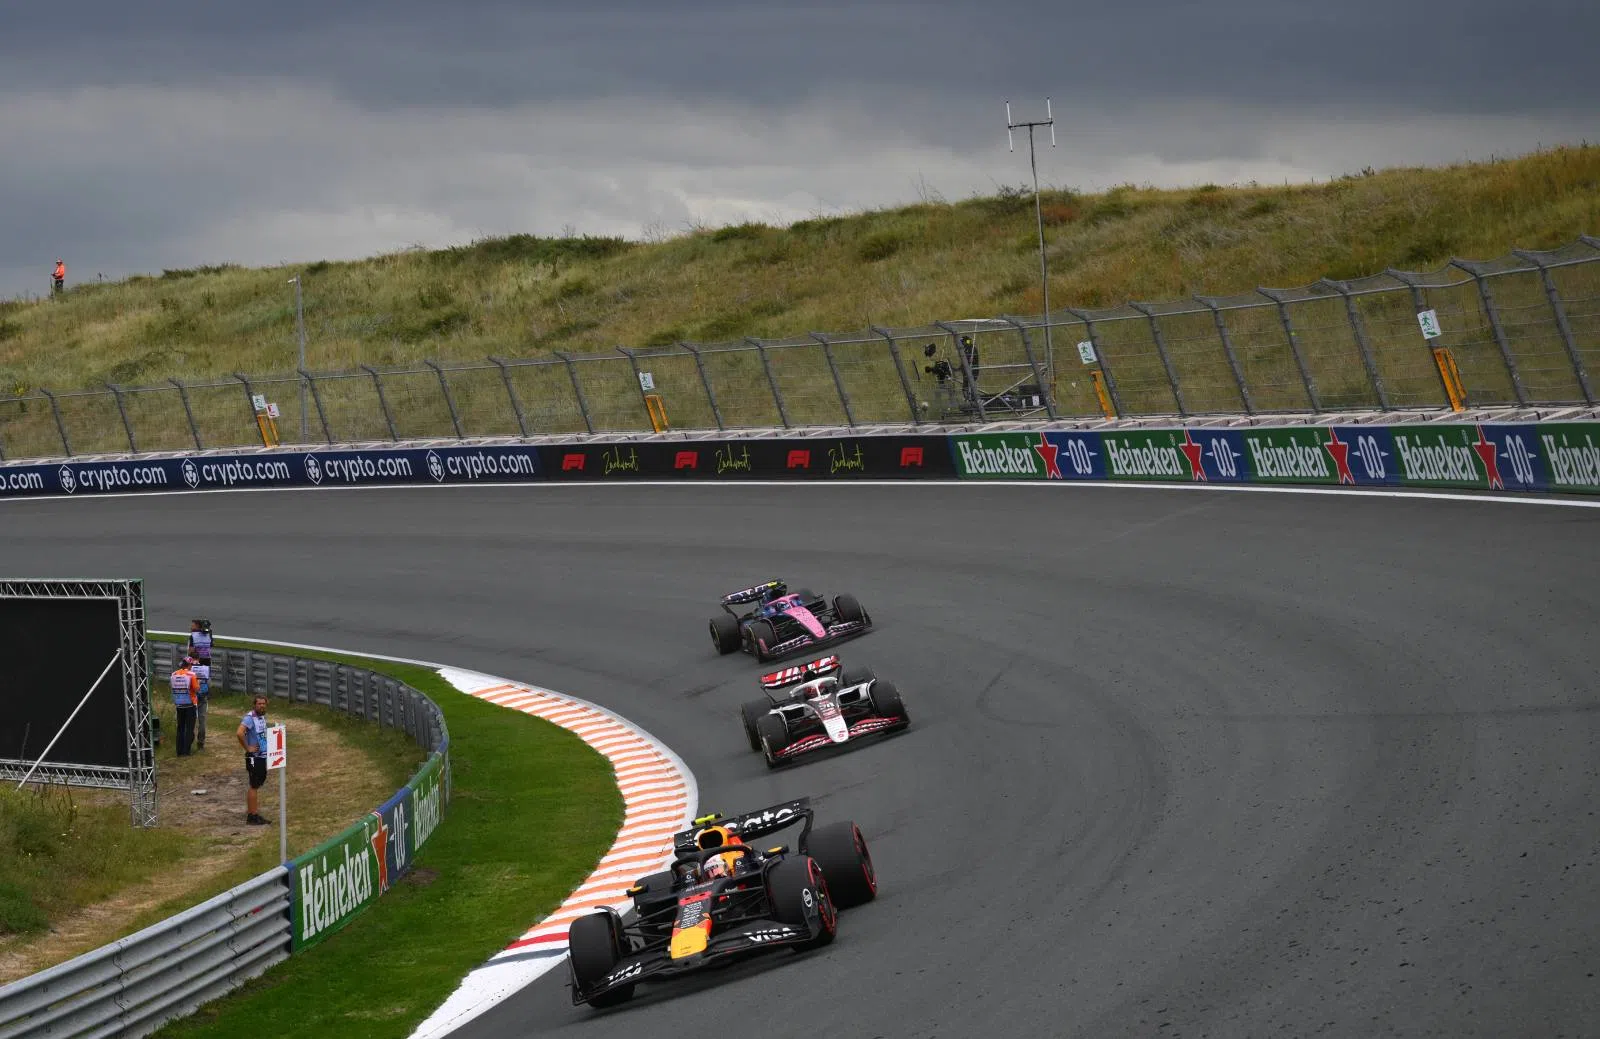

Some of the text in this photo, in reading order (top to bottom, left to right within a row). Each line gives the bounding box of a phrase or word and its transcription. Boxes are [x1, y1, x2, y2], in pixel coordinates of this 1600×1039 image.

[202, 459, 290, 485] crypto.com
[325, 456, 413, 482] crypto.com
[447, 451, 534, 479] crypto.com
[958, 440, 1037, 474] Heineken
[1105, 439, 1183, 475] Heineken
[1248, 436, 1329, 477] Heineken
[1395, 434, 1479, 481] Heineken
[79, 465, 168, 490] crypto.com
[300, 842, 372, 941] Heineken
